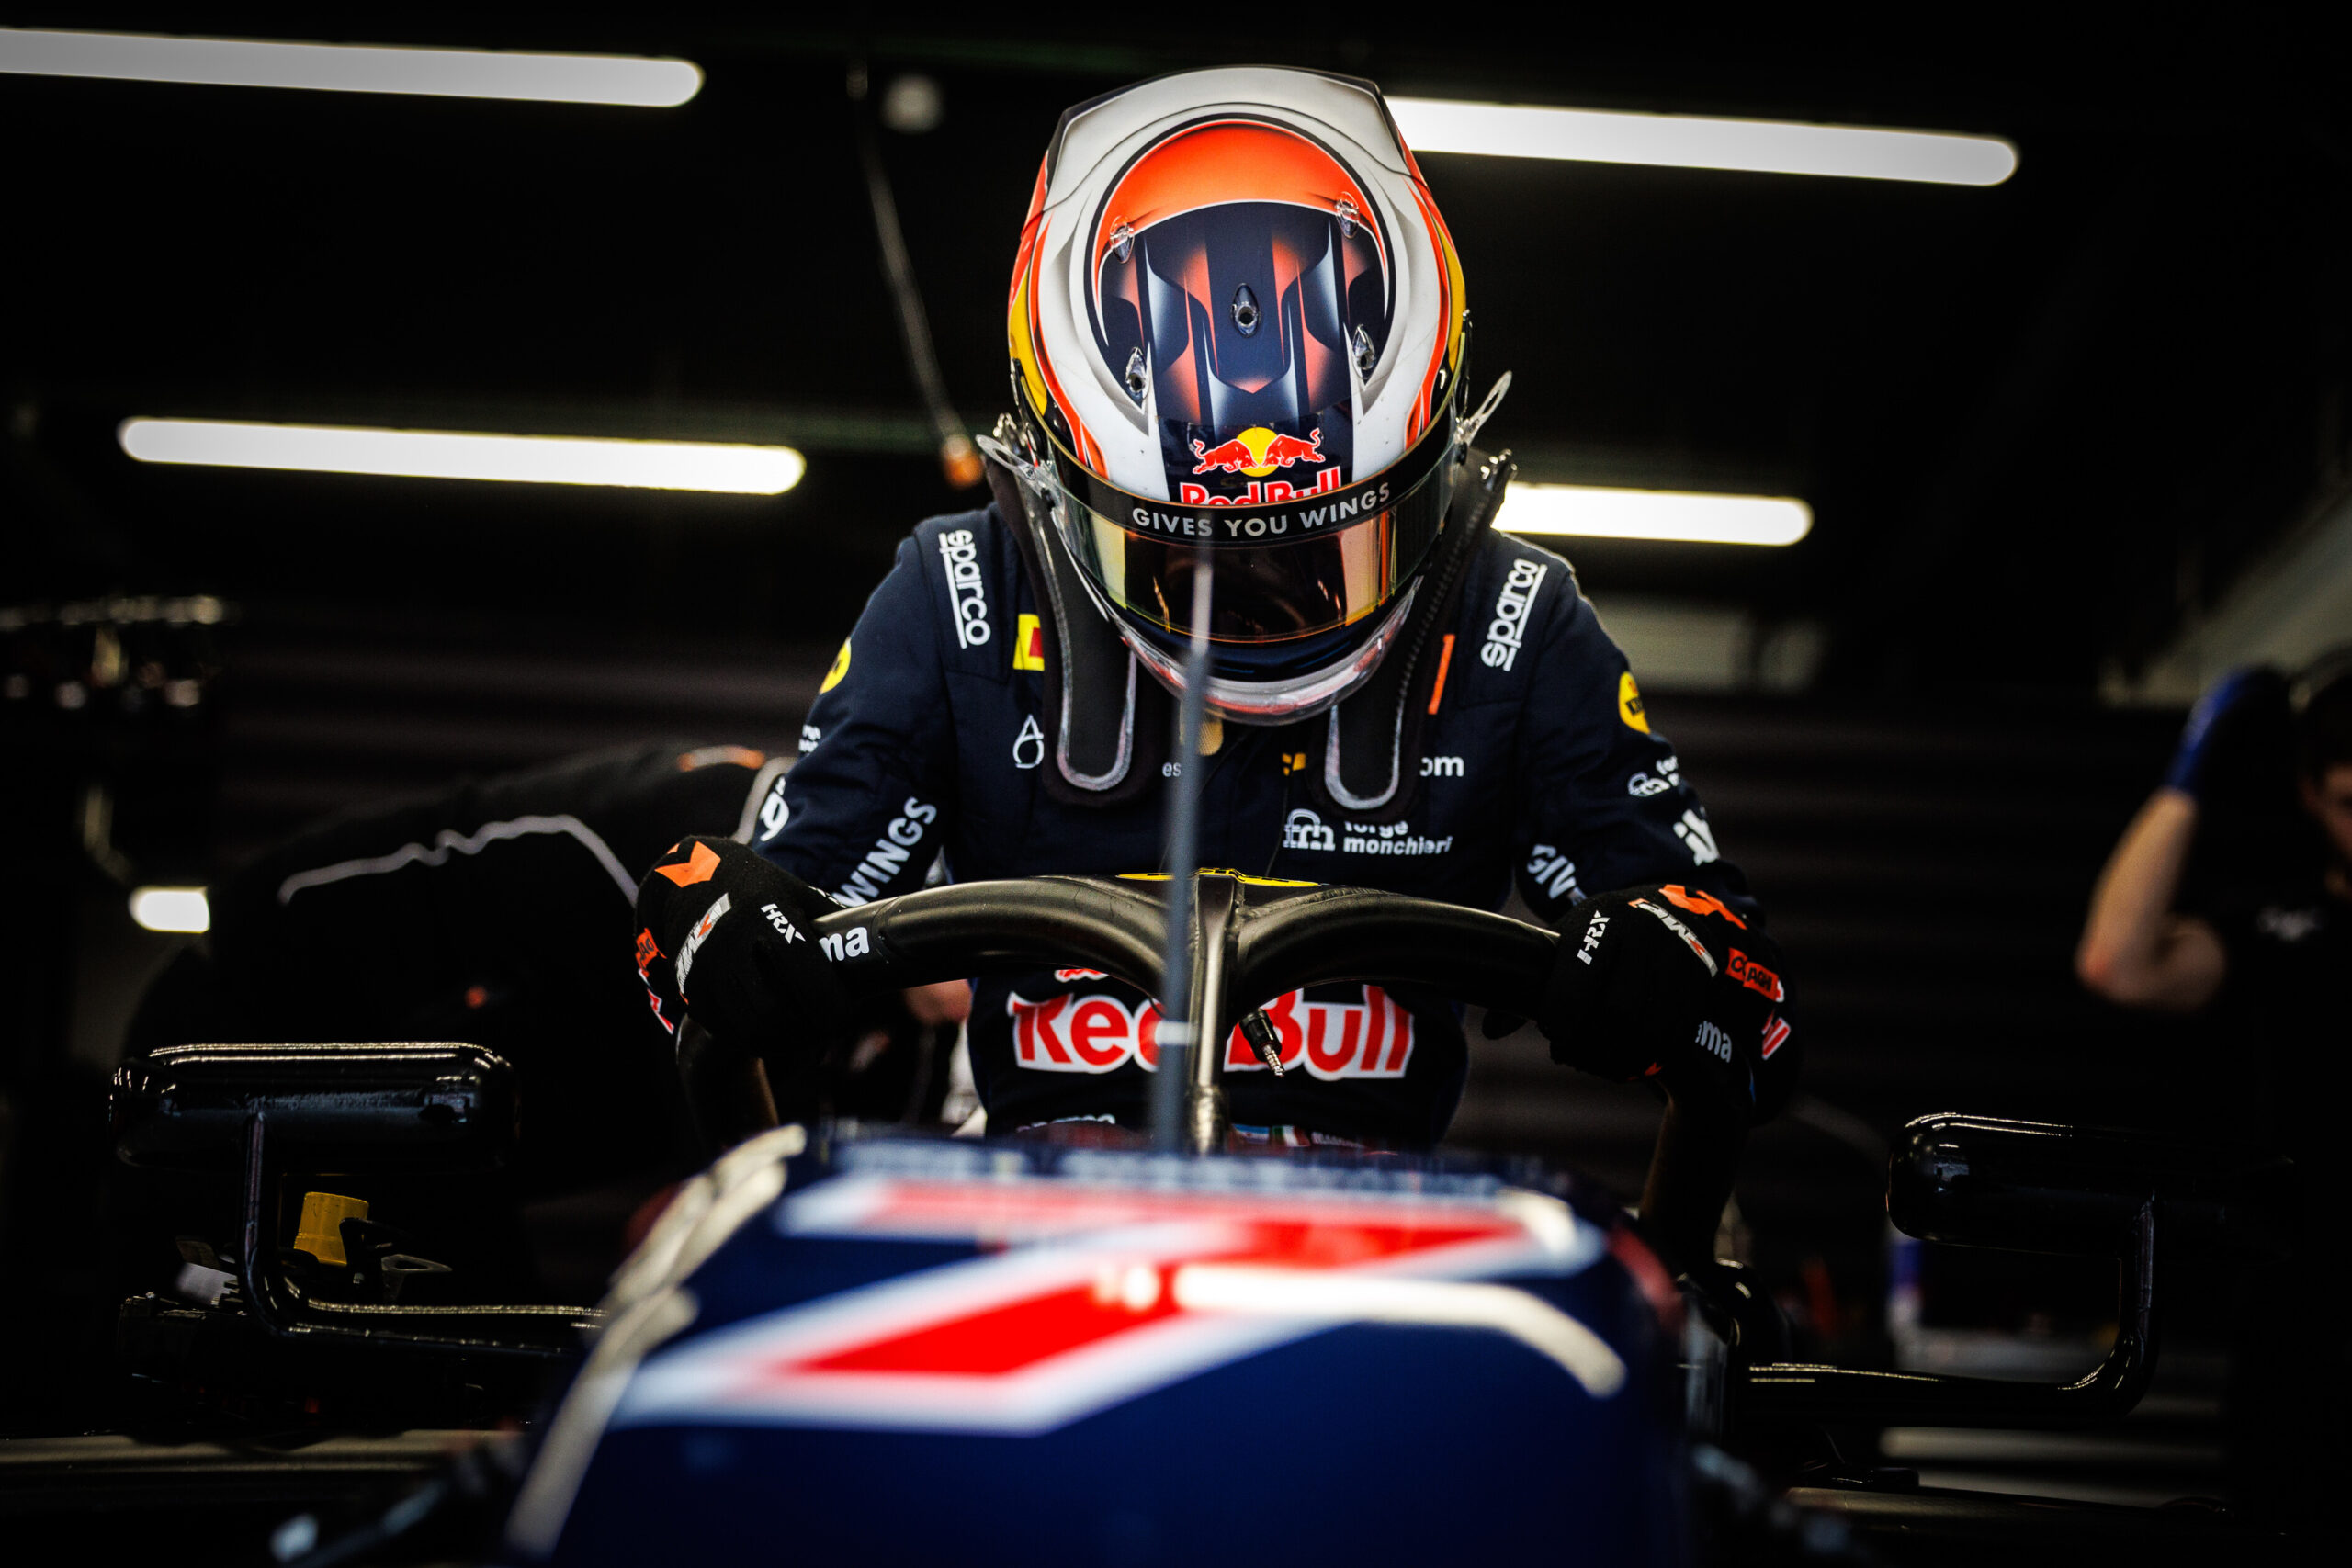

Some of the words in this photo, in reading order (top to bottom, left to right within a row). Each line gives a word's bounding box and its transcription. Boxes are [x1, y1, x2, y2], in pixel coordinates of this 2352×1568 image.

[1132, 507, 1212, 536] GIVES
[1225, 515, 1287, 537] YOU
[1299, 482, 1390, 529] WINGS
[938, 529, 991, 649] sparco
[1480, 558, 1548, 671] sparco
[831, 796, 937, 908] WINGS
[1343, 836, 1453, 856] monchieri
